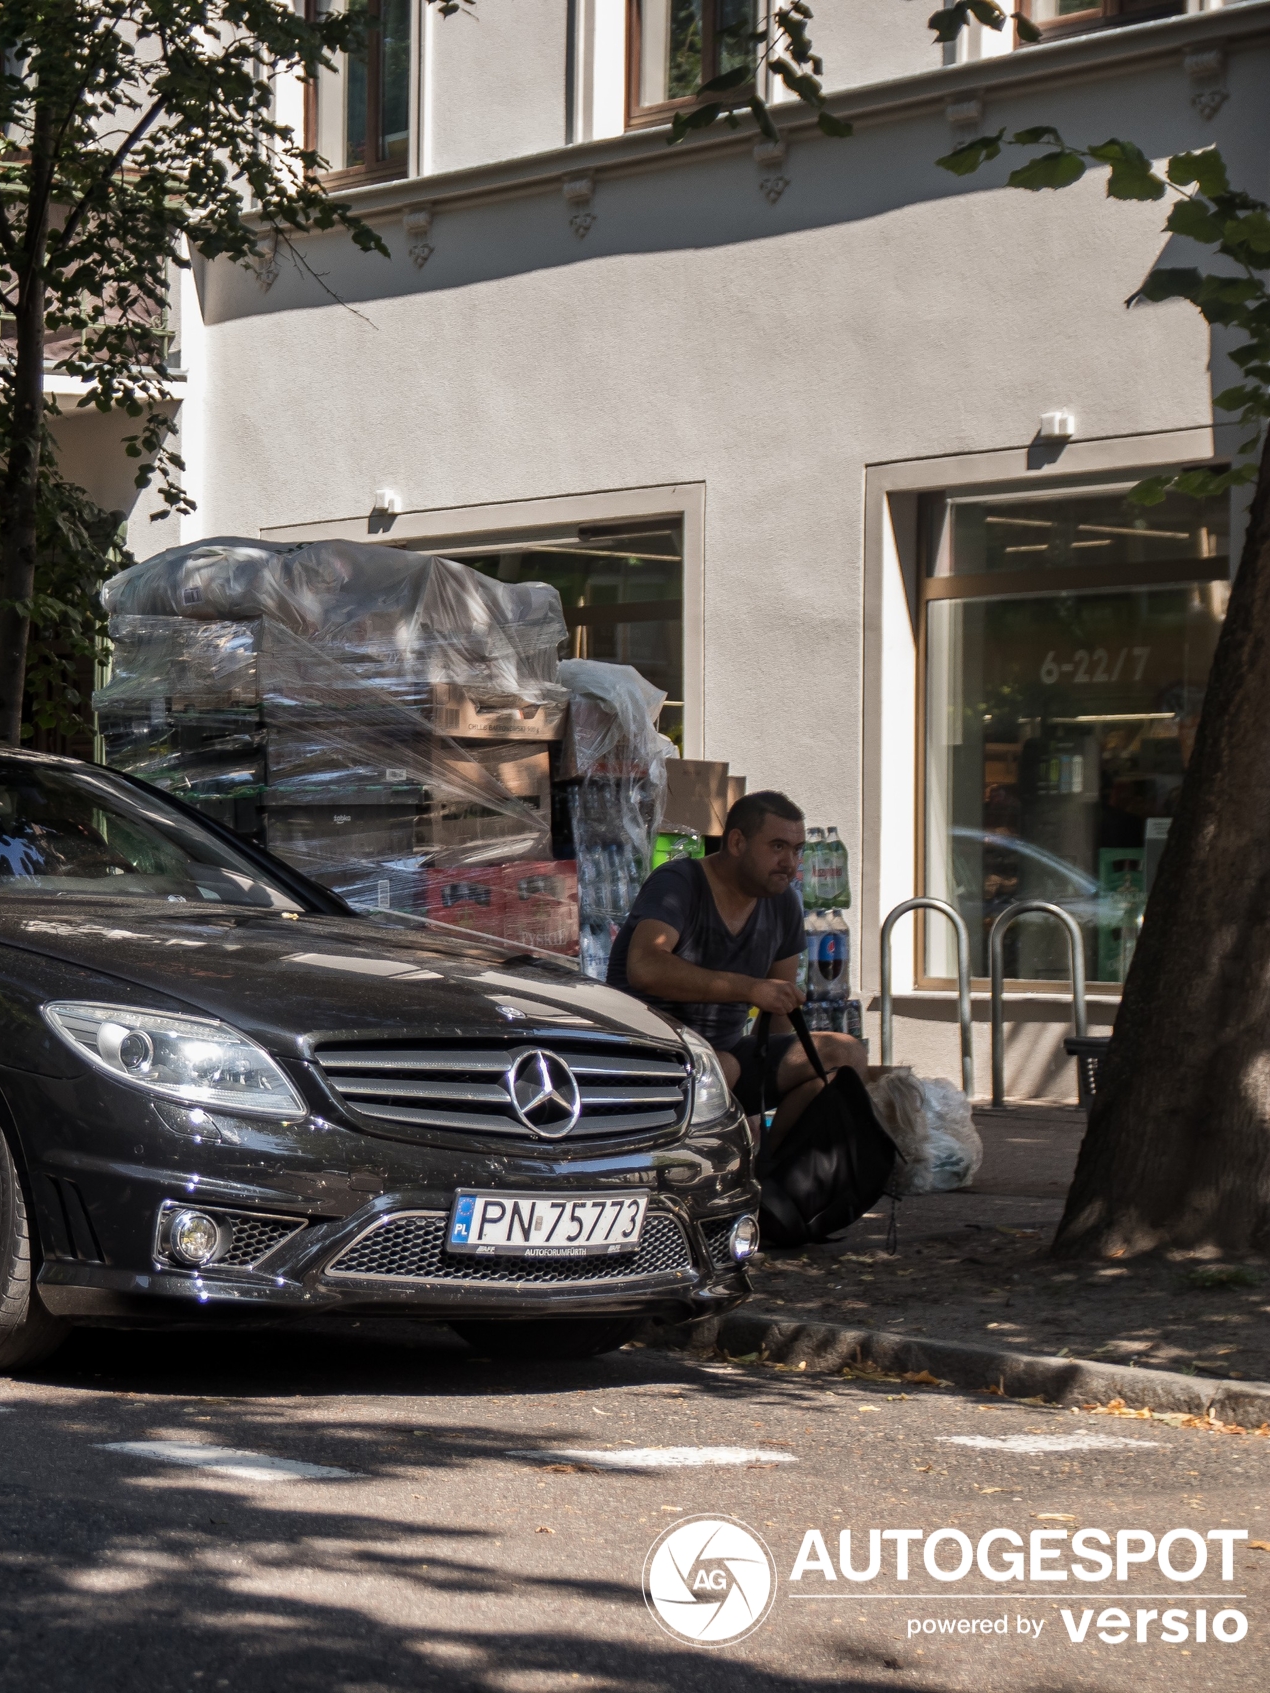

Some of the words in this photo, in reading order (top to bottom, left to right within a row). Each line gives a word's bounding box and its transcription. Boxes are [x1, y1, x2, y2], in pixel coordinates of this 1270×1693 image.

[1040, 646, 1151, 684] 6-22/7
[454, 1223, 468, 1236] PL
[477, 1200, 536, 1242] PN
[544, 1199, 640, 1242] 75773
